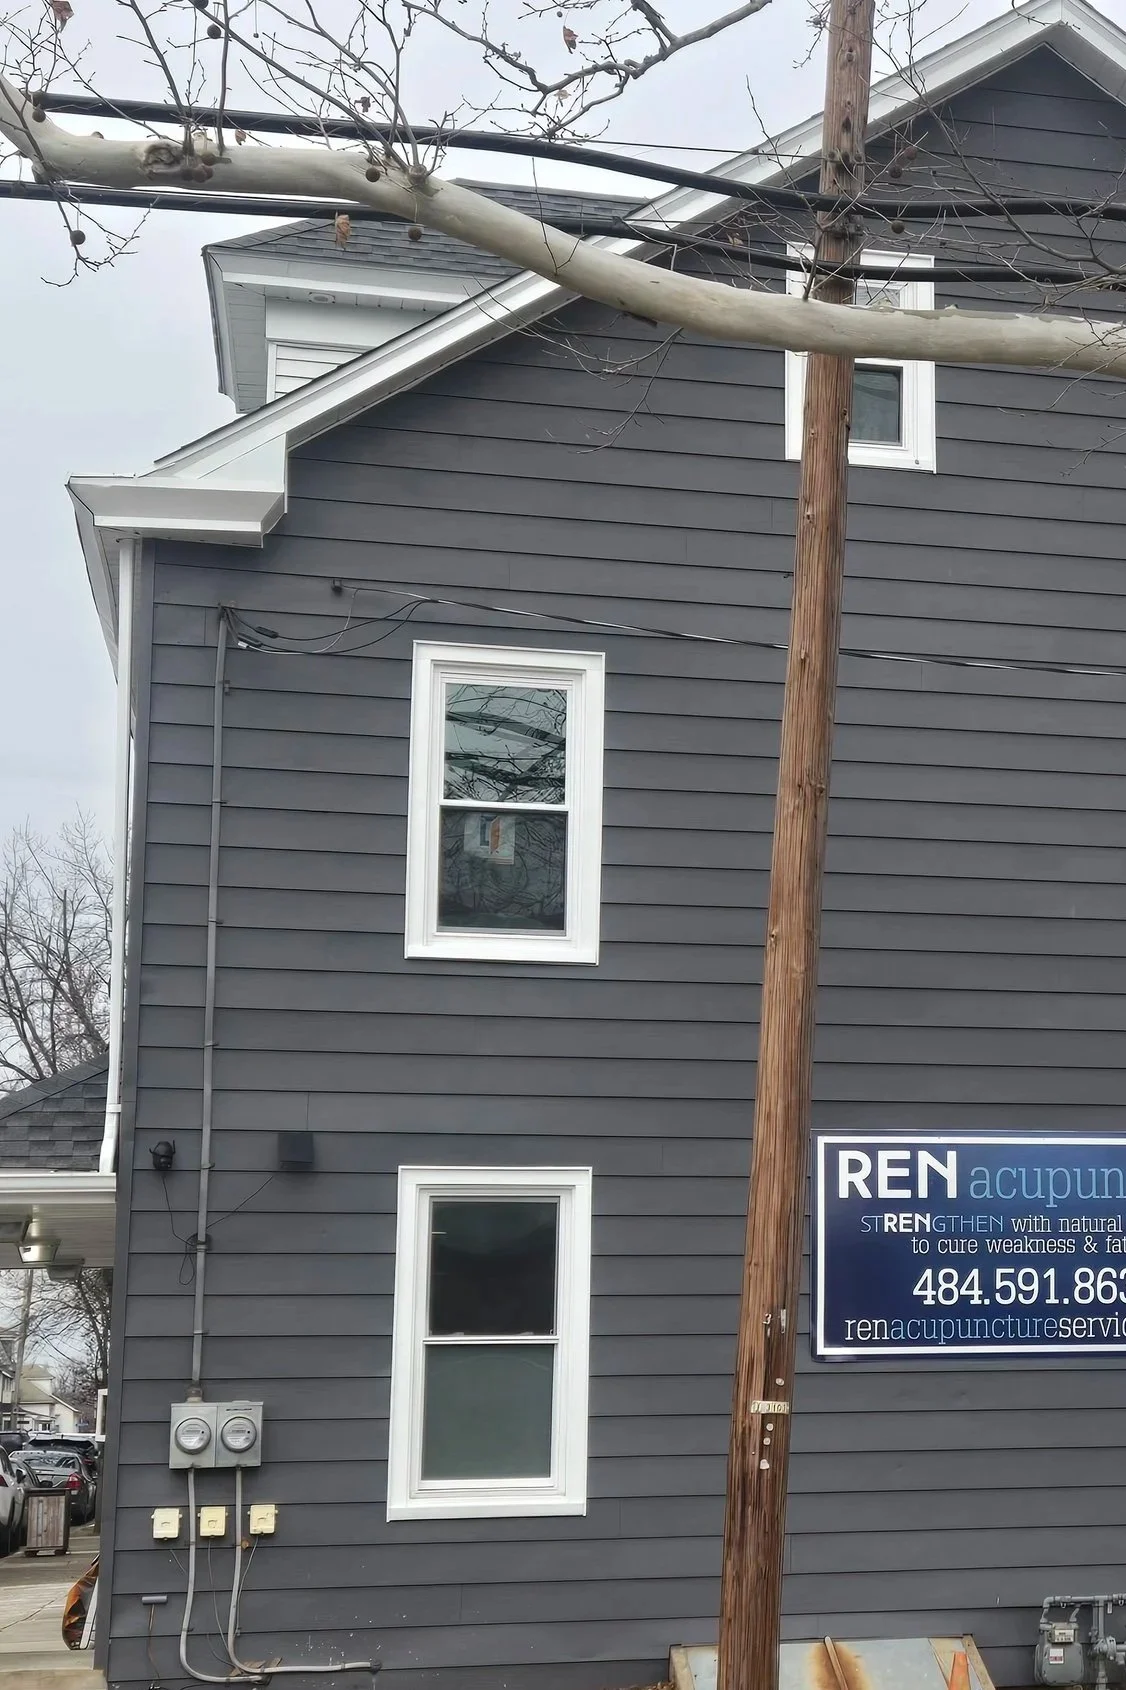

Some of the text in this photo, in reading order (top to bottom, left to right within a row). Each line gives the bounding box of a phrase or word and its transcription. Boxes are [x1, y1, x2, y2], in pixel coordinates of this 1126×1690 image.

[838, 1150, 957, 1199] REN
[860, 1213, 1004, 1234] STRENGTHEN
[1011, 1215, 1051, 1233] with
[1058, 1215, 1122, 1233] natural
[911, 1236, 930, 1254] to
[937, 1238, 978, 1254] cure
[986, 1235, 1076, 1254] weakness
[1083, 1236, 1098, 1254] &
